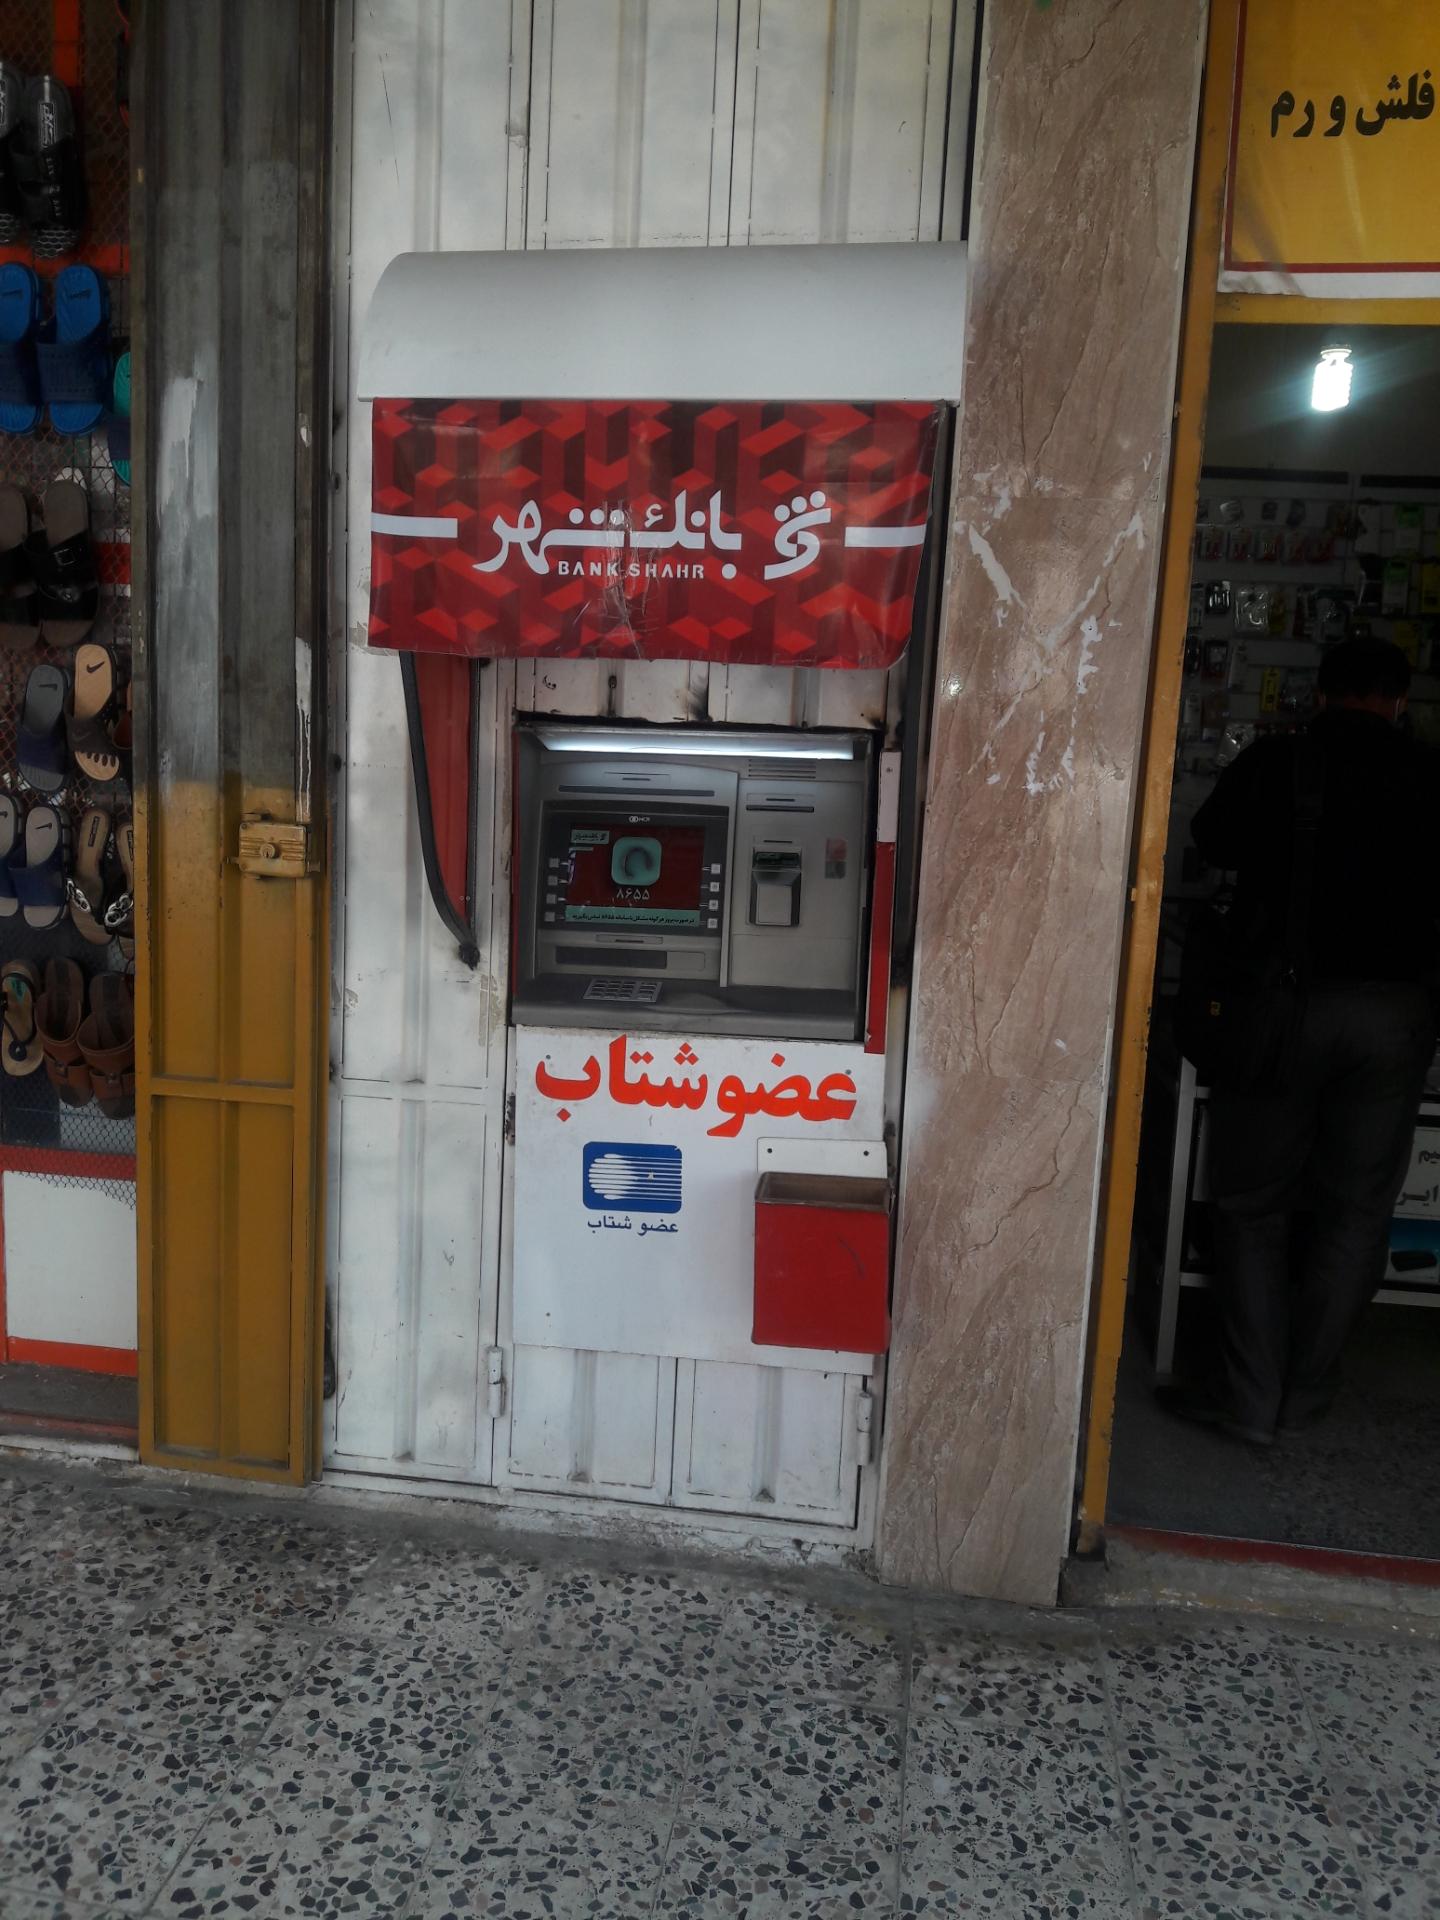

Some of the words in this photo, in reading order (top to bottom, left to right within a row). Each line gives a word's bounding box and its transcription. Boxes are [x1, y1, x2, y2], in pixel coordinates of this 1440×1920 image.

[1270, 90, 1316, 138] رم
[1323, 94, 1347, 137] و
[1355, 69, 1436, 136] فلش
[472, 498, 626, 576] شهر
[558, 560, 619, 577] BANK
[628, 562, 706, 580] SHAHR
[616, 887, 650, 901] ۸۶۵۵
[535, 1033, 708, 1122] شتاب
[706, 1052, 857, 1138] عضو
[587, 1214, 632, 1231] شتاب
[638, 1220, 679, 1236] عضو
